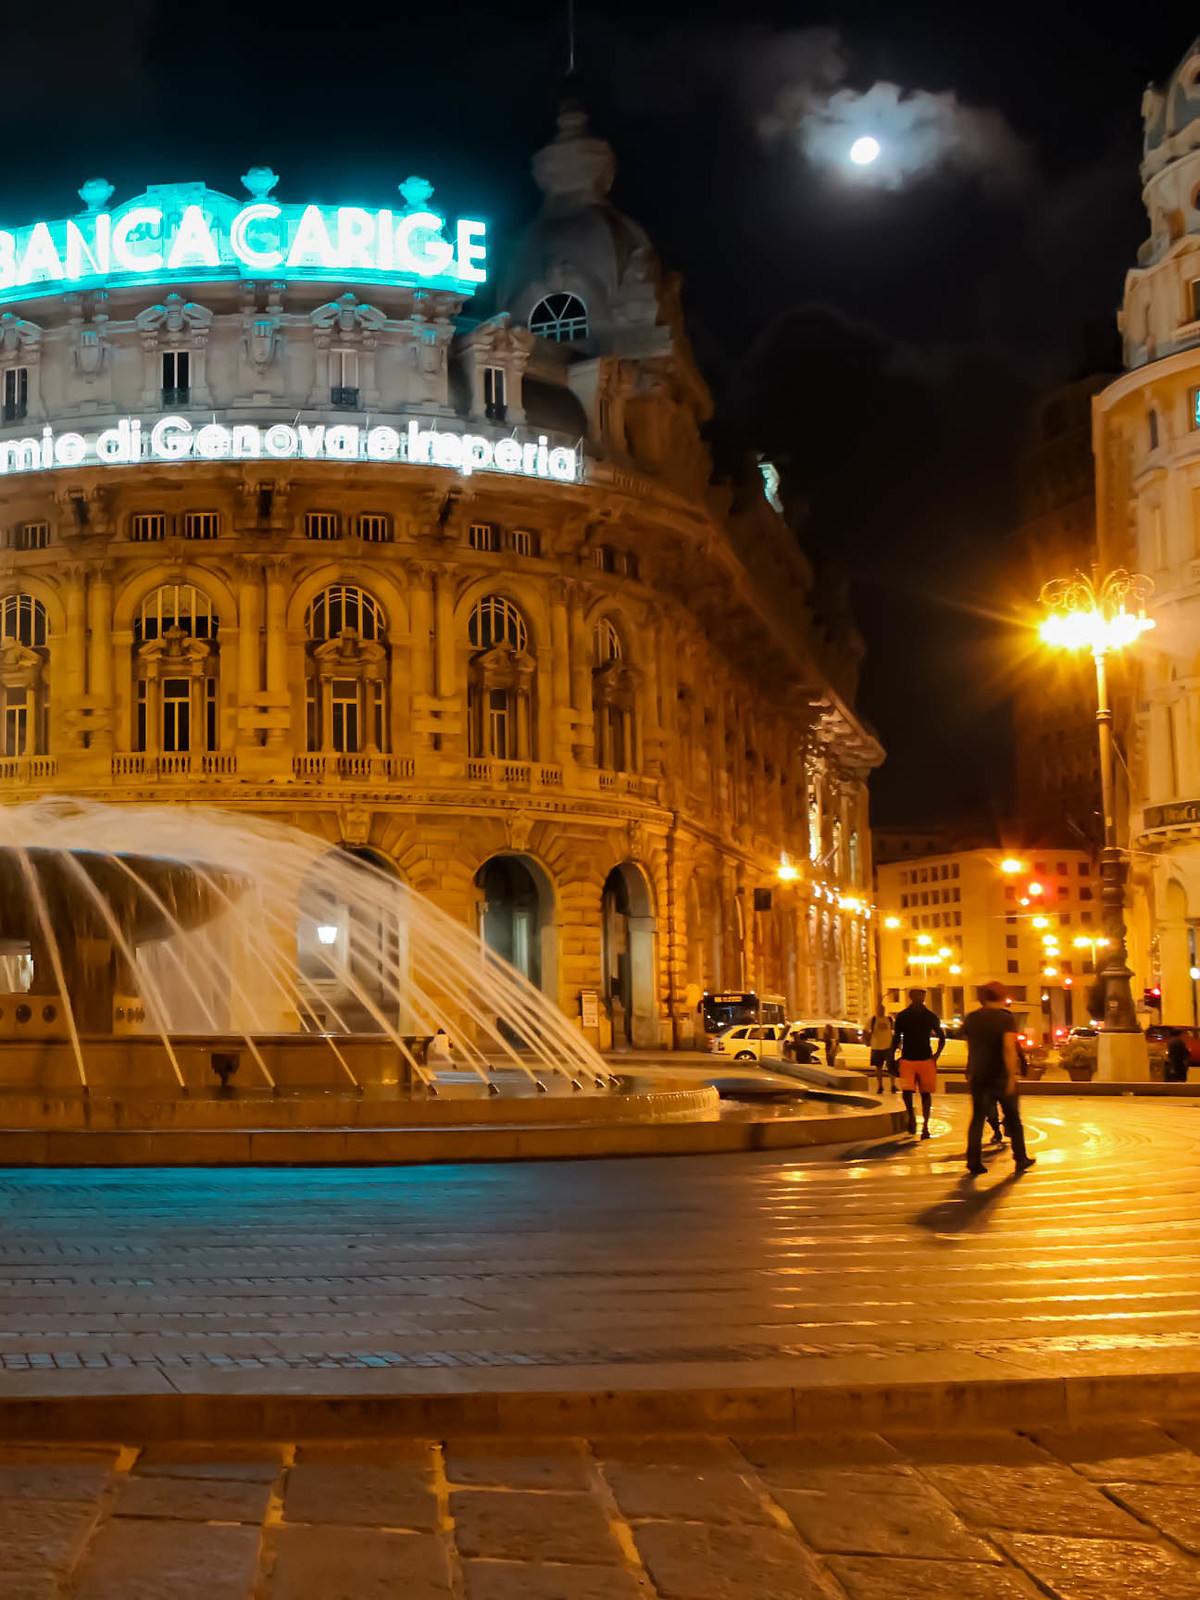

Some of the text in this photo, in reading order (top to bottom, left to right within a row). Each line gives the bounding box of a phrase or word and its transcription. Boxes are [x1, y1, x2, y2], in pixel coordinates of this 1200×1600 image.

[230, 203, 487, 283] CARIGE
[96, 418, 142, 463] di
[150, 415, 359, 460] Genova
[367, 425, 400, 460] e
[407, 420, 576, 481] Imperia
